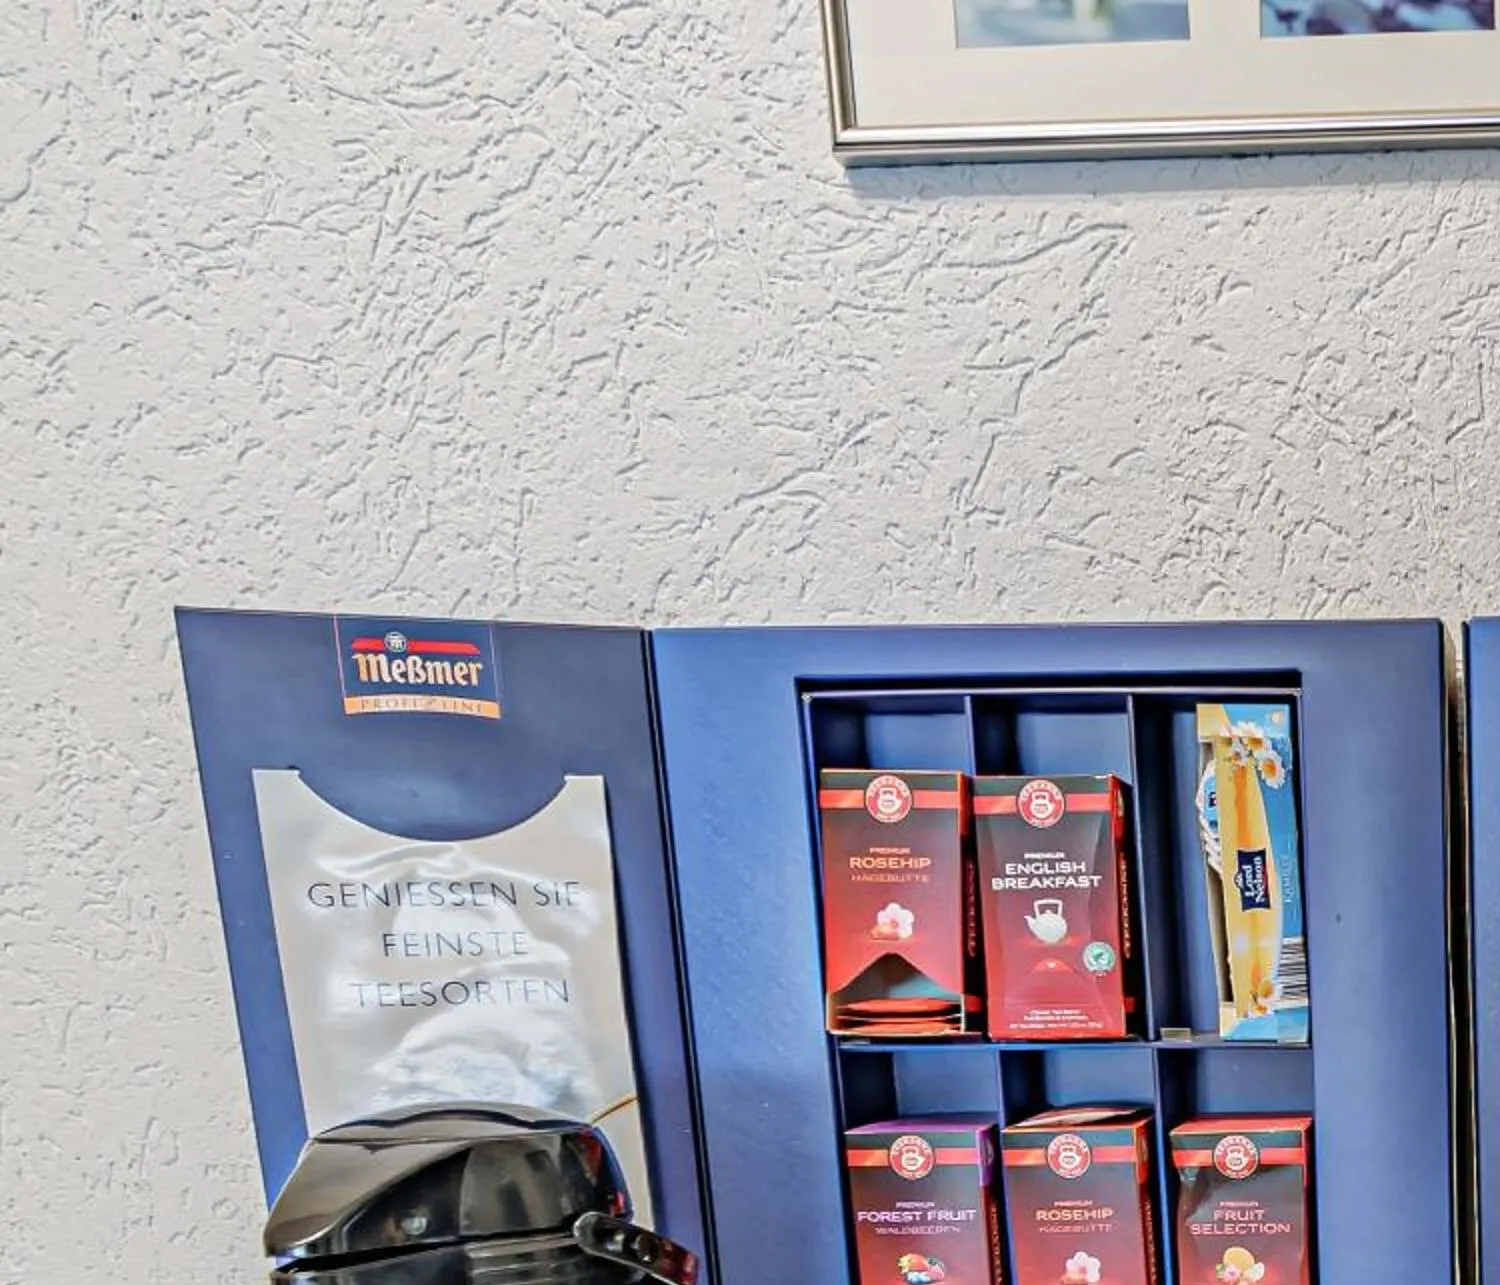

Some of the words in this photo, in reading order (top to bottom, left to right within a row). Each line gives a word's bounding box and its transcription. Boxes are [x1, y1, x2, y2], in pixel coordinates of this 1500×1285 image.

[352, 653, 484, 687] Meßmer
[849, 857, 932, 869] ROSEHIP
[1004, 861, 1086, 876] ENGLISH
[991, 875, 1103, 890] BREAKFAST
[1242, 865, 1255, 897] Lord
[1253, 857, 1266, 903] Nelson
[307, 881, 518, 908] GENIESSEN
[383, 931, 529, 957] FEINSTE
[857, 1211, 922, 1222] FOREST
[927, 1209, 977, 1221] FRUIT
[1036, 1207, 1114, 1220] ROSEHIP
[1213, 1209, 1265, 1221] FRUIT
[1191, 1223, 1291, 1235] SELECTION
